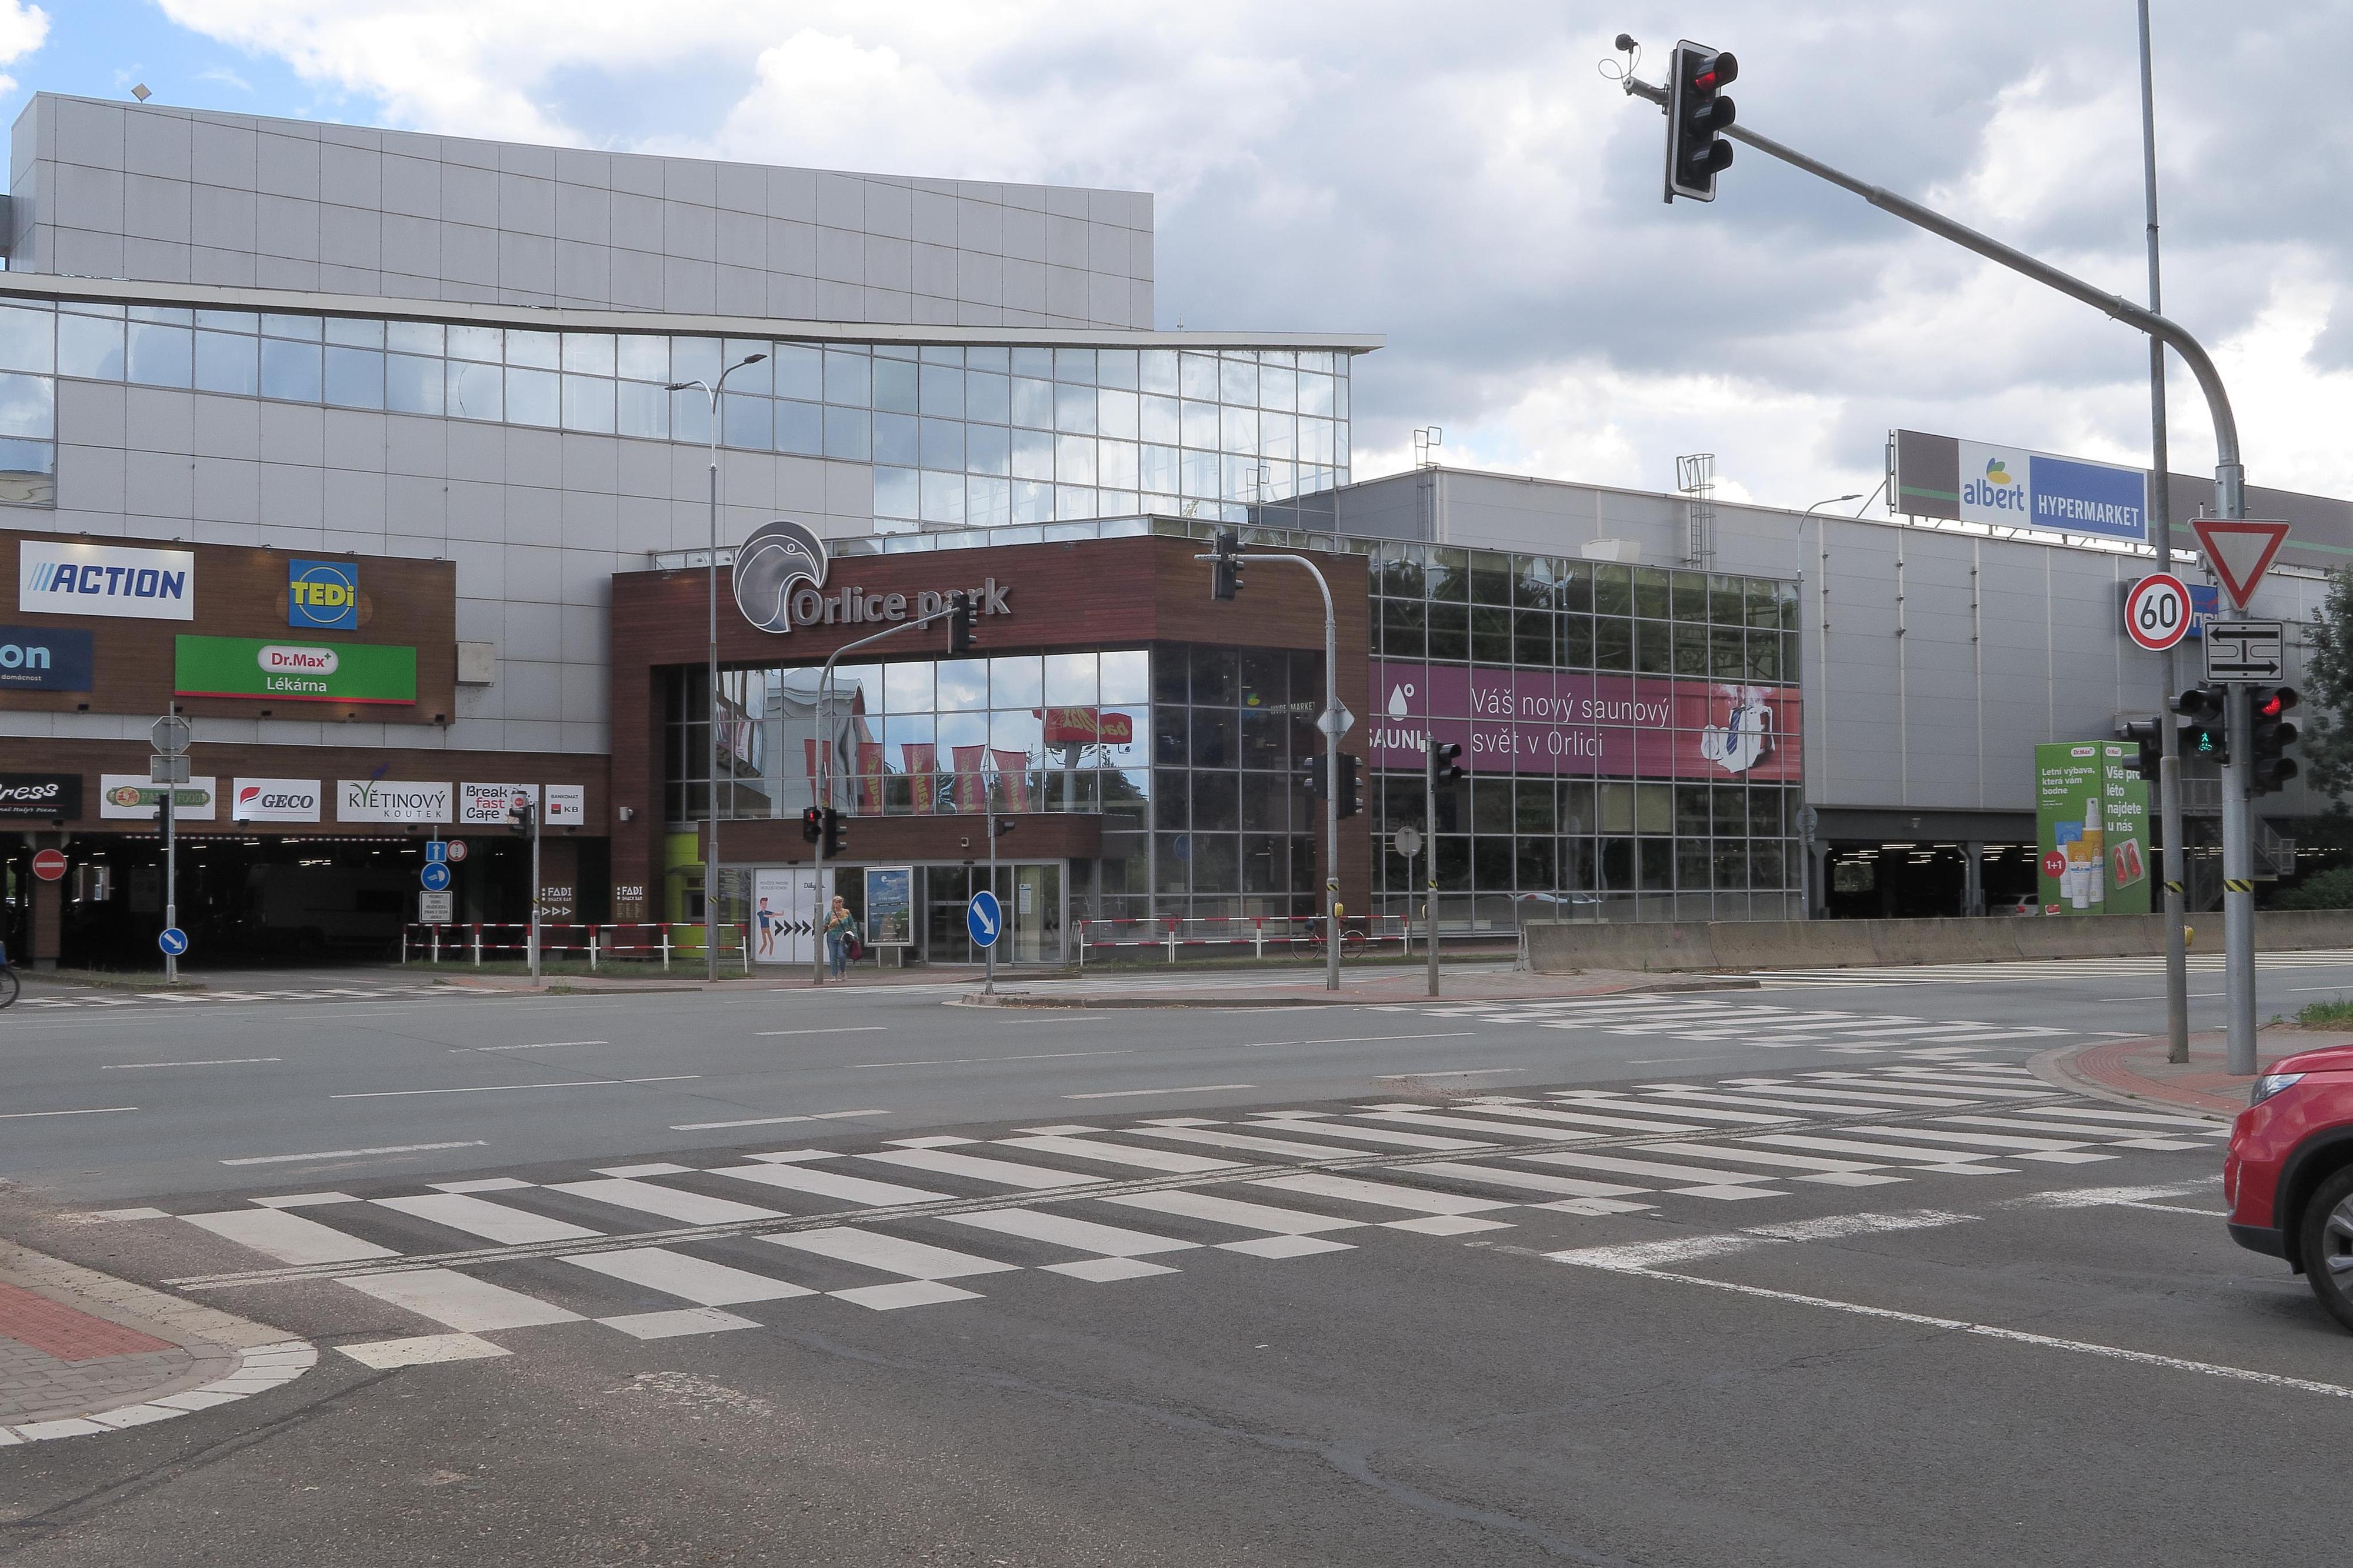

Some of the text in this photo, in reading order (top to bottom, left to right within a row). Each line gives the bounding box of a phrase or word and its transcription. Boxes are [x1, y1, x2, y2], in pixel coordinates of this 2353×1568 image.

[1964, 478, 2025, 512] albert
[2038, 494, 2139, 528] HYPERMARKET
[49, 564, 186, 599] ACTION
[291, 581, 355, 608] TEDi
[792, 586, 907, 626] Orlice
[2140, 593, 2177, 630] 60
[266, 676, 327, 693] Lékárna
[1472, 688, 1669, 728] Váš nový saunový
[1369, 729, 1431, 749] AUNI
[1472, 728, 1603, 757] svět v Orlici
[2042, 767, 2062, 776] Letní
[2106, 765, 2124, 779] Vše
[0, 783, 59, 799] ress
[466, 785, 508, 798] Break
[2107, 783, 2124, 796] léto
[178, 794, 202, 803] FOOD
[262, 794, 314, 809] GECO
[475, 797, 505, 809] fast
[466, 807, 500, 821] Cafe
[2107, 801, 2142, 817] najdete
[2108, 819, 2133, 832] u nás
[2046, 860, 2062, 870] 1+1
[548, 888, 572, 896] FADI
[622, 886, 643, 895] FADI
